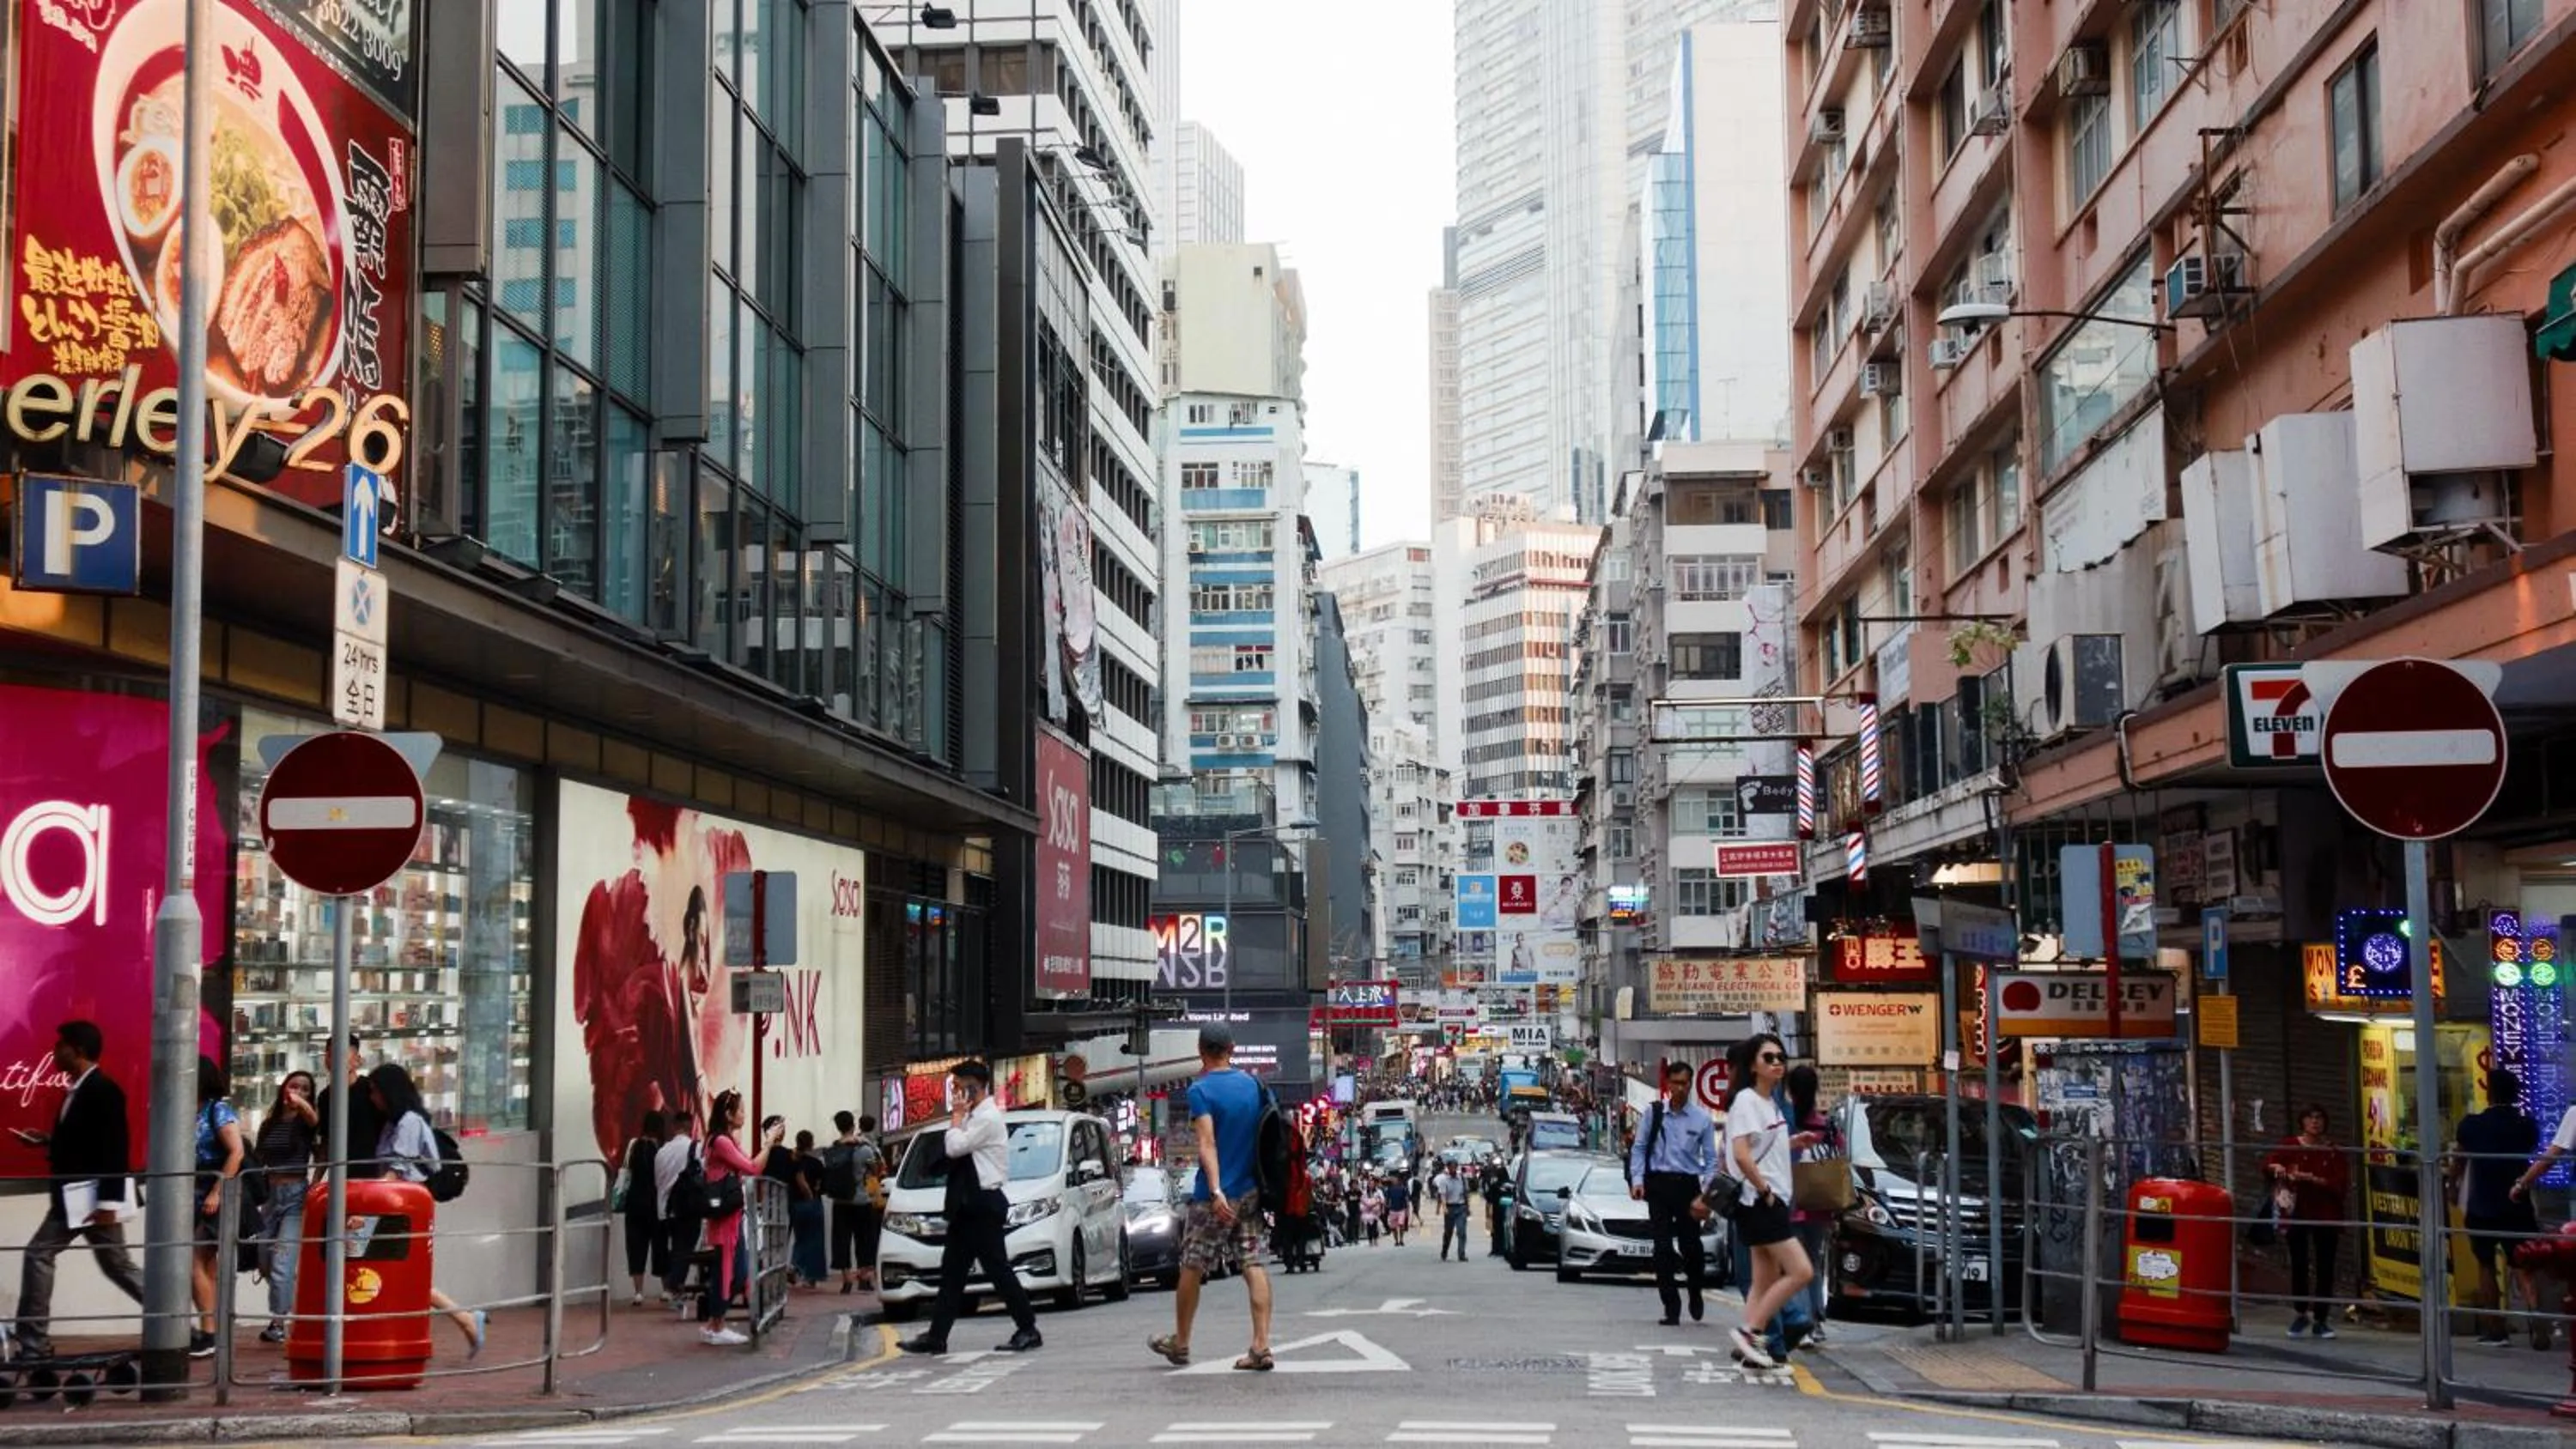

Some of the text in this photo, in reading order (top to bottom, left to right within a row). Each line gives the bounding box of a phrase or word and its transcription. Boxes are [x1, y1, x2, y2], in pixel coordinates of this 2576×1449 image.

[288, 385, 410, 475] 26
[44, 489, 115, 574] P
[346, 679, 374, 718] 全日
[1148, 914, 1228, 955] M2R
[2208, 916, 2222, 972] P
[1843, 1003, 1907, 1017] WENGER
[1512, 1028, 1546, 1040] MIA
